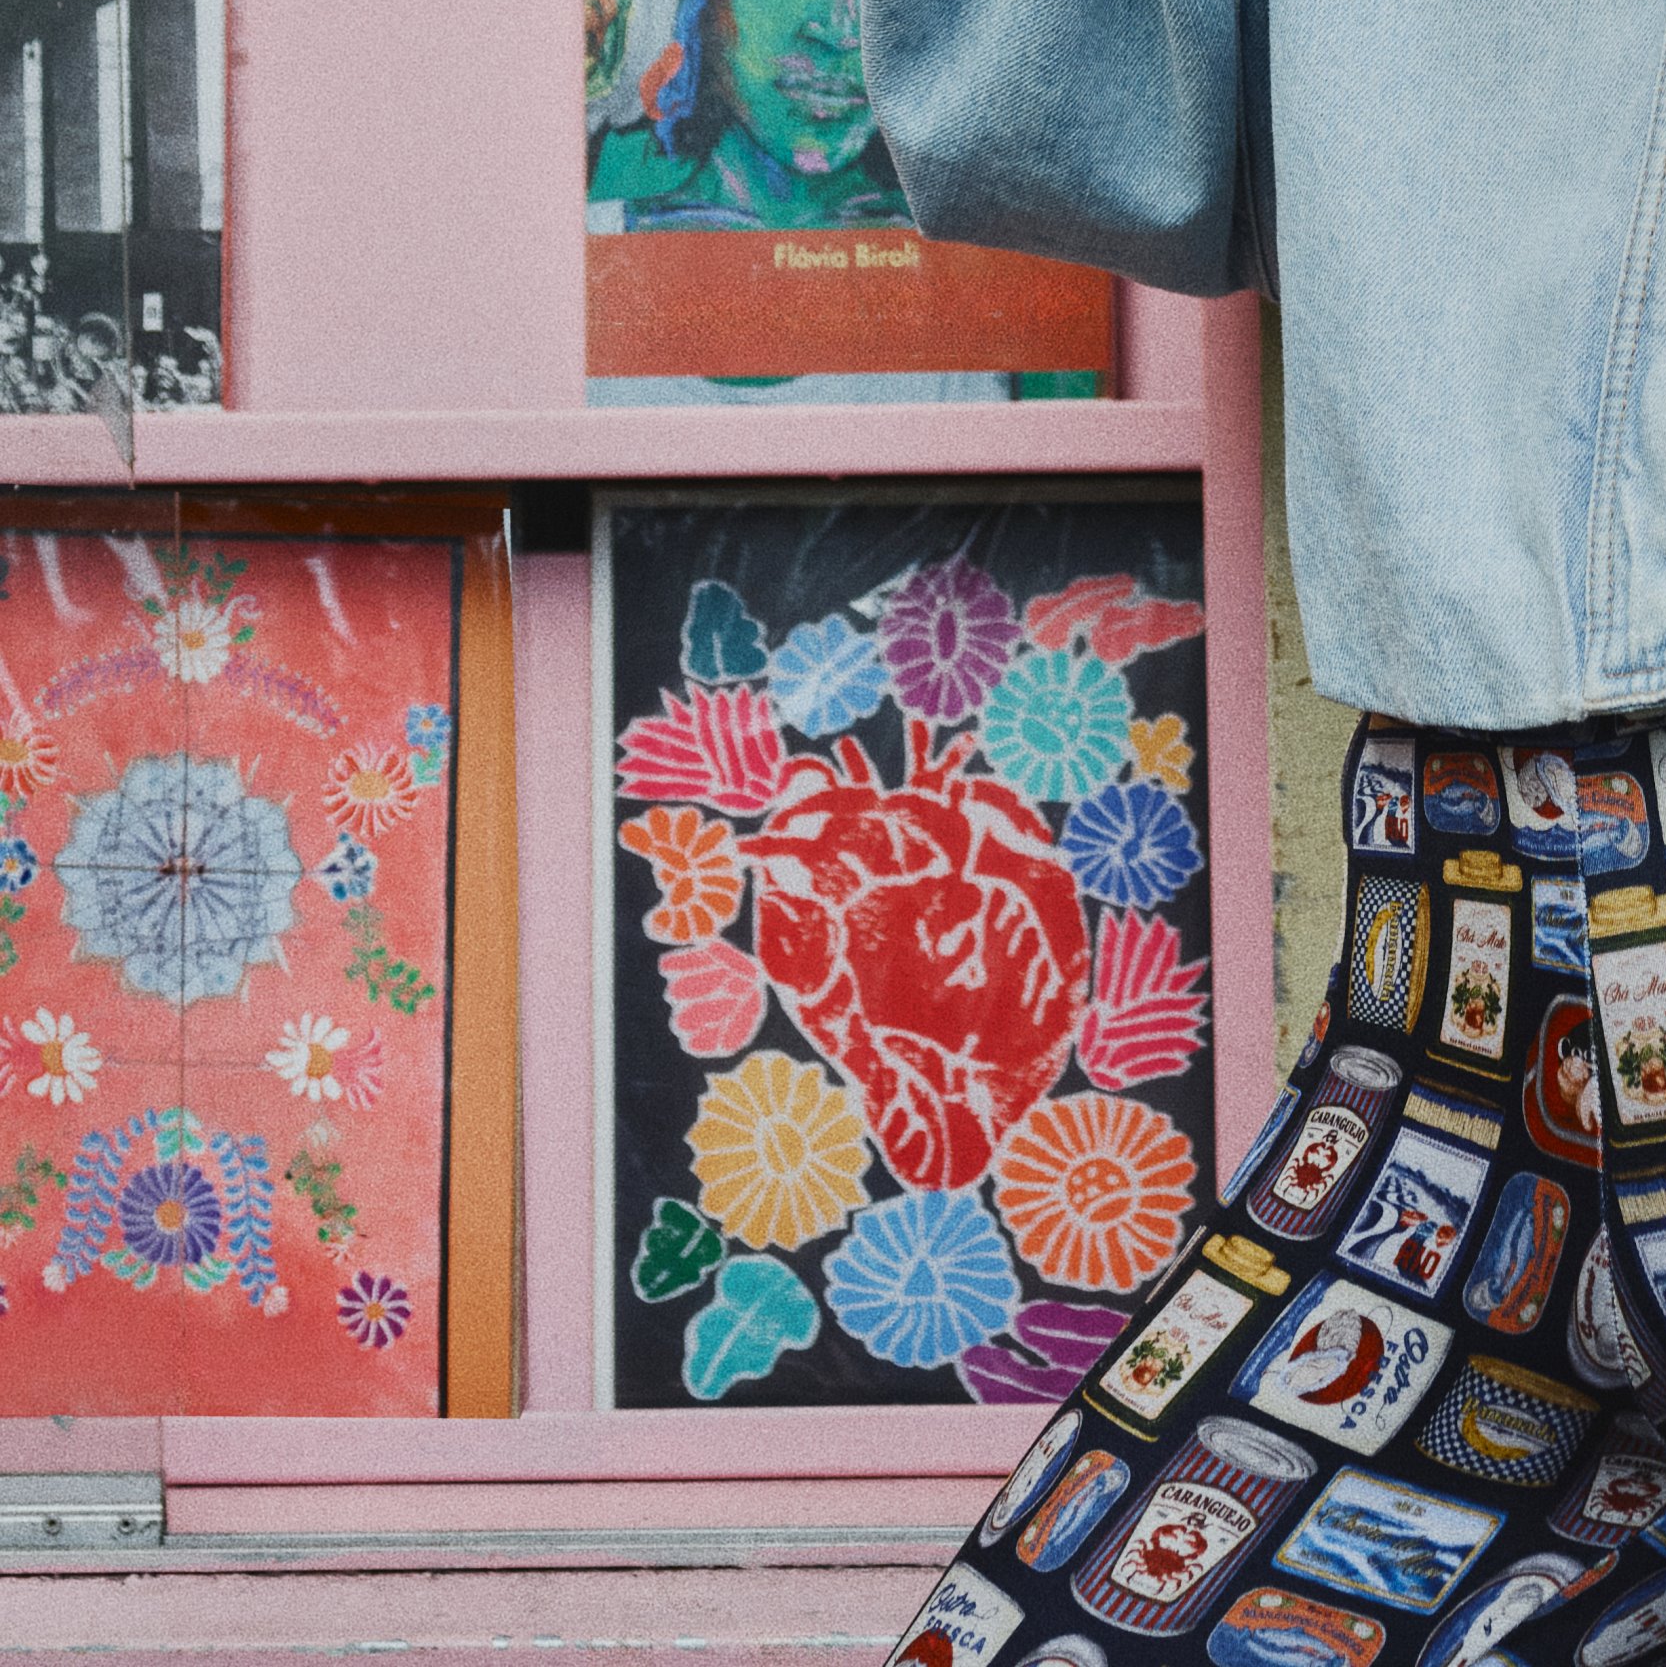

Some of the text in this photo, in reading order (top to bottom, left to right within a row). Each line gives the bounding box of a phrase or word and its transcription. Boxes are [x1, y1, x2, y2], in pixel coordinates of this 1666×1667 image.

[855, 241, 919, 269] Biroli
[1604, 981, 1630, 1007] Chá
[1310, 1110, 1366, 1144] CARANGUEJO
[1393, 1237, 1442, 1281] RIO
[1160, 1485, 1251, 1533] CARANGUEJO
